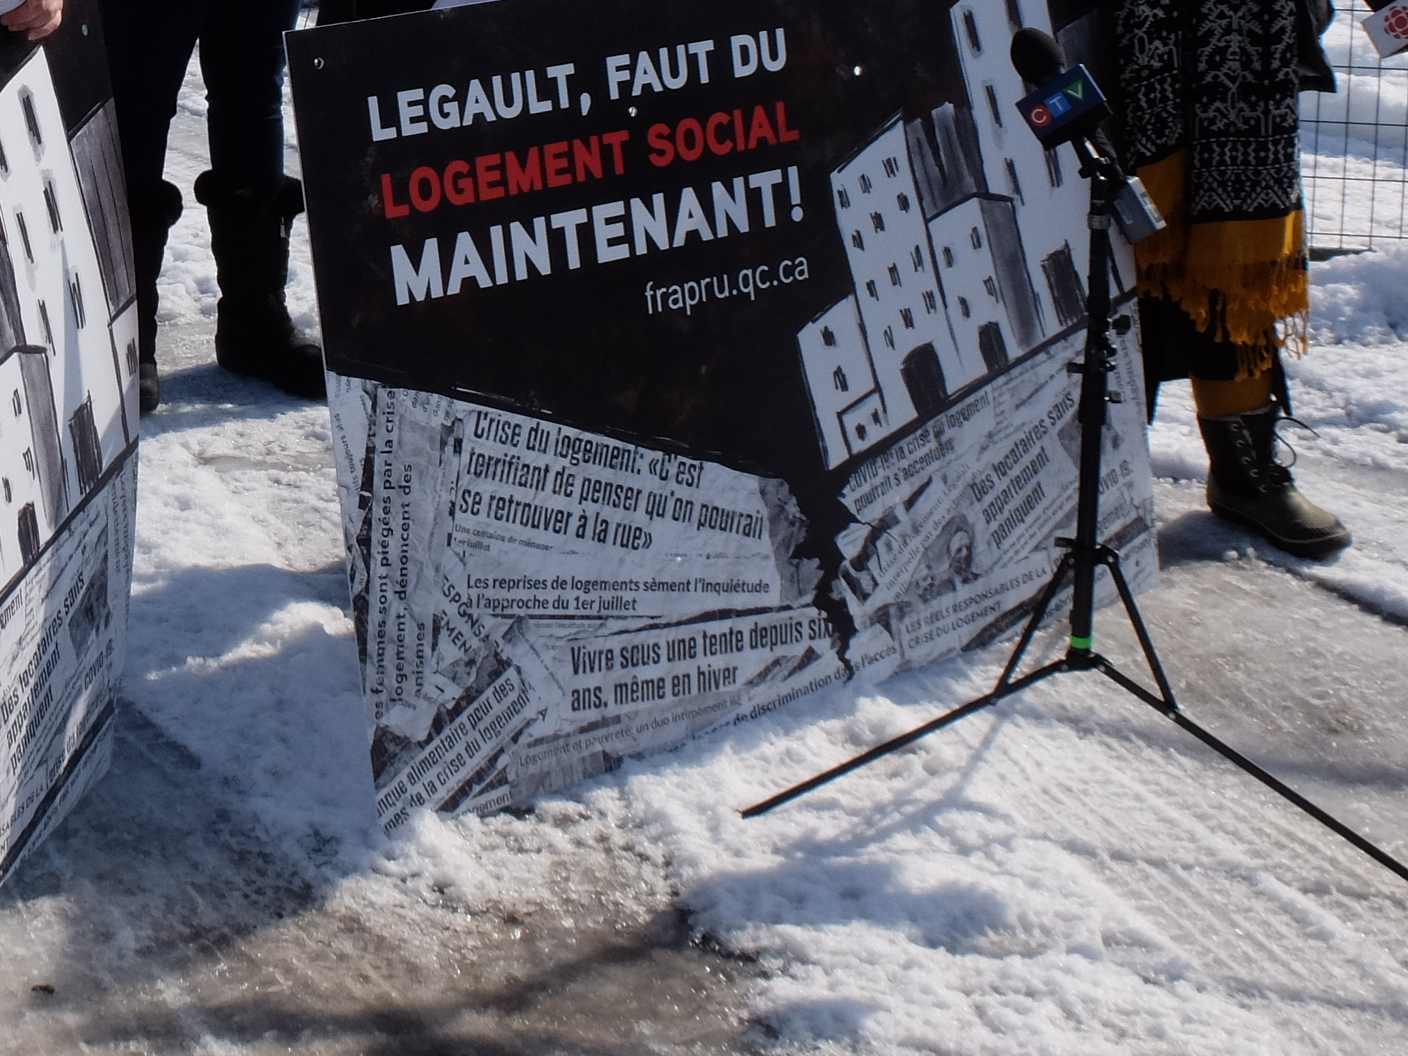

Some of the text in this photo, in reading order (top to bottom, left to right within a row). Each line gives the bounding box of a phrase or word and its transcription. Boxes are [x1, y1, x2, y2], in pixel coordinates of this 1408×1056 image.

[367, 27, 787, 142] LEGAULT, FAUT DU
[1030, 78, 1085, 127] CTV
[381, 101, 800, 219] LOGEMENT SOCIAL
[390, 165, 804, 306] MAINTENANT!
[645, 255, 809, 315] frapru.qc.ca
[473, 409, 705, 490] Crise du logement: «C'est
[907, 428, 931, 455] crise
[945, 390, 991, 433] logement
[971, 391, 1075, 503] Des locataires sans
[459, 487, 653, 552] se retrouver à la rue»
[467, 445, 764, 542] terrifiant de penser qu'on pourrait
[981, 445, 1050, 526] appartement
[991, 481, 1047, 550] paniquent
[371, 390, 396, 694] femmes sont piégées par la crise
[392, 463, 413, 703] logement, dénoncent des
[467, 574, 770, 598] Les reprises de logements sèment l'inquiétude
[476, 594, 549, 615] l'approche
[552, 594, 570, 611] du
[574, 596, 595, 611] 1er
[594, 597, 637, 615] juillet
[905, 565, 1048, 635] LES RÉELS RESPONSABLES DE LA
[0, 569, 85, 726] Des locataires sans
[570, 645, 614, 676] Vivre
[620, 641, 661, 670] sous
[666, 638, 698, 664] une
[701, 628, 745, 658] tente
[749, 619, 803, 654] depuis
[907, 600, 1003, 651] CRISE DU LOGEMENT
[6, 641, 61, 751] appartement
[570, 664, 740, 712] ans, même en hiver
[749, 676, 833, 721] discrimination
[9, 684, 54, 776] paniquent
[406, 676, 516, 787] alimentaire pour des
[423, 688, 532, 798] la crise du logement
